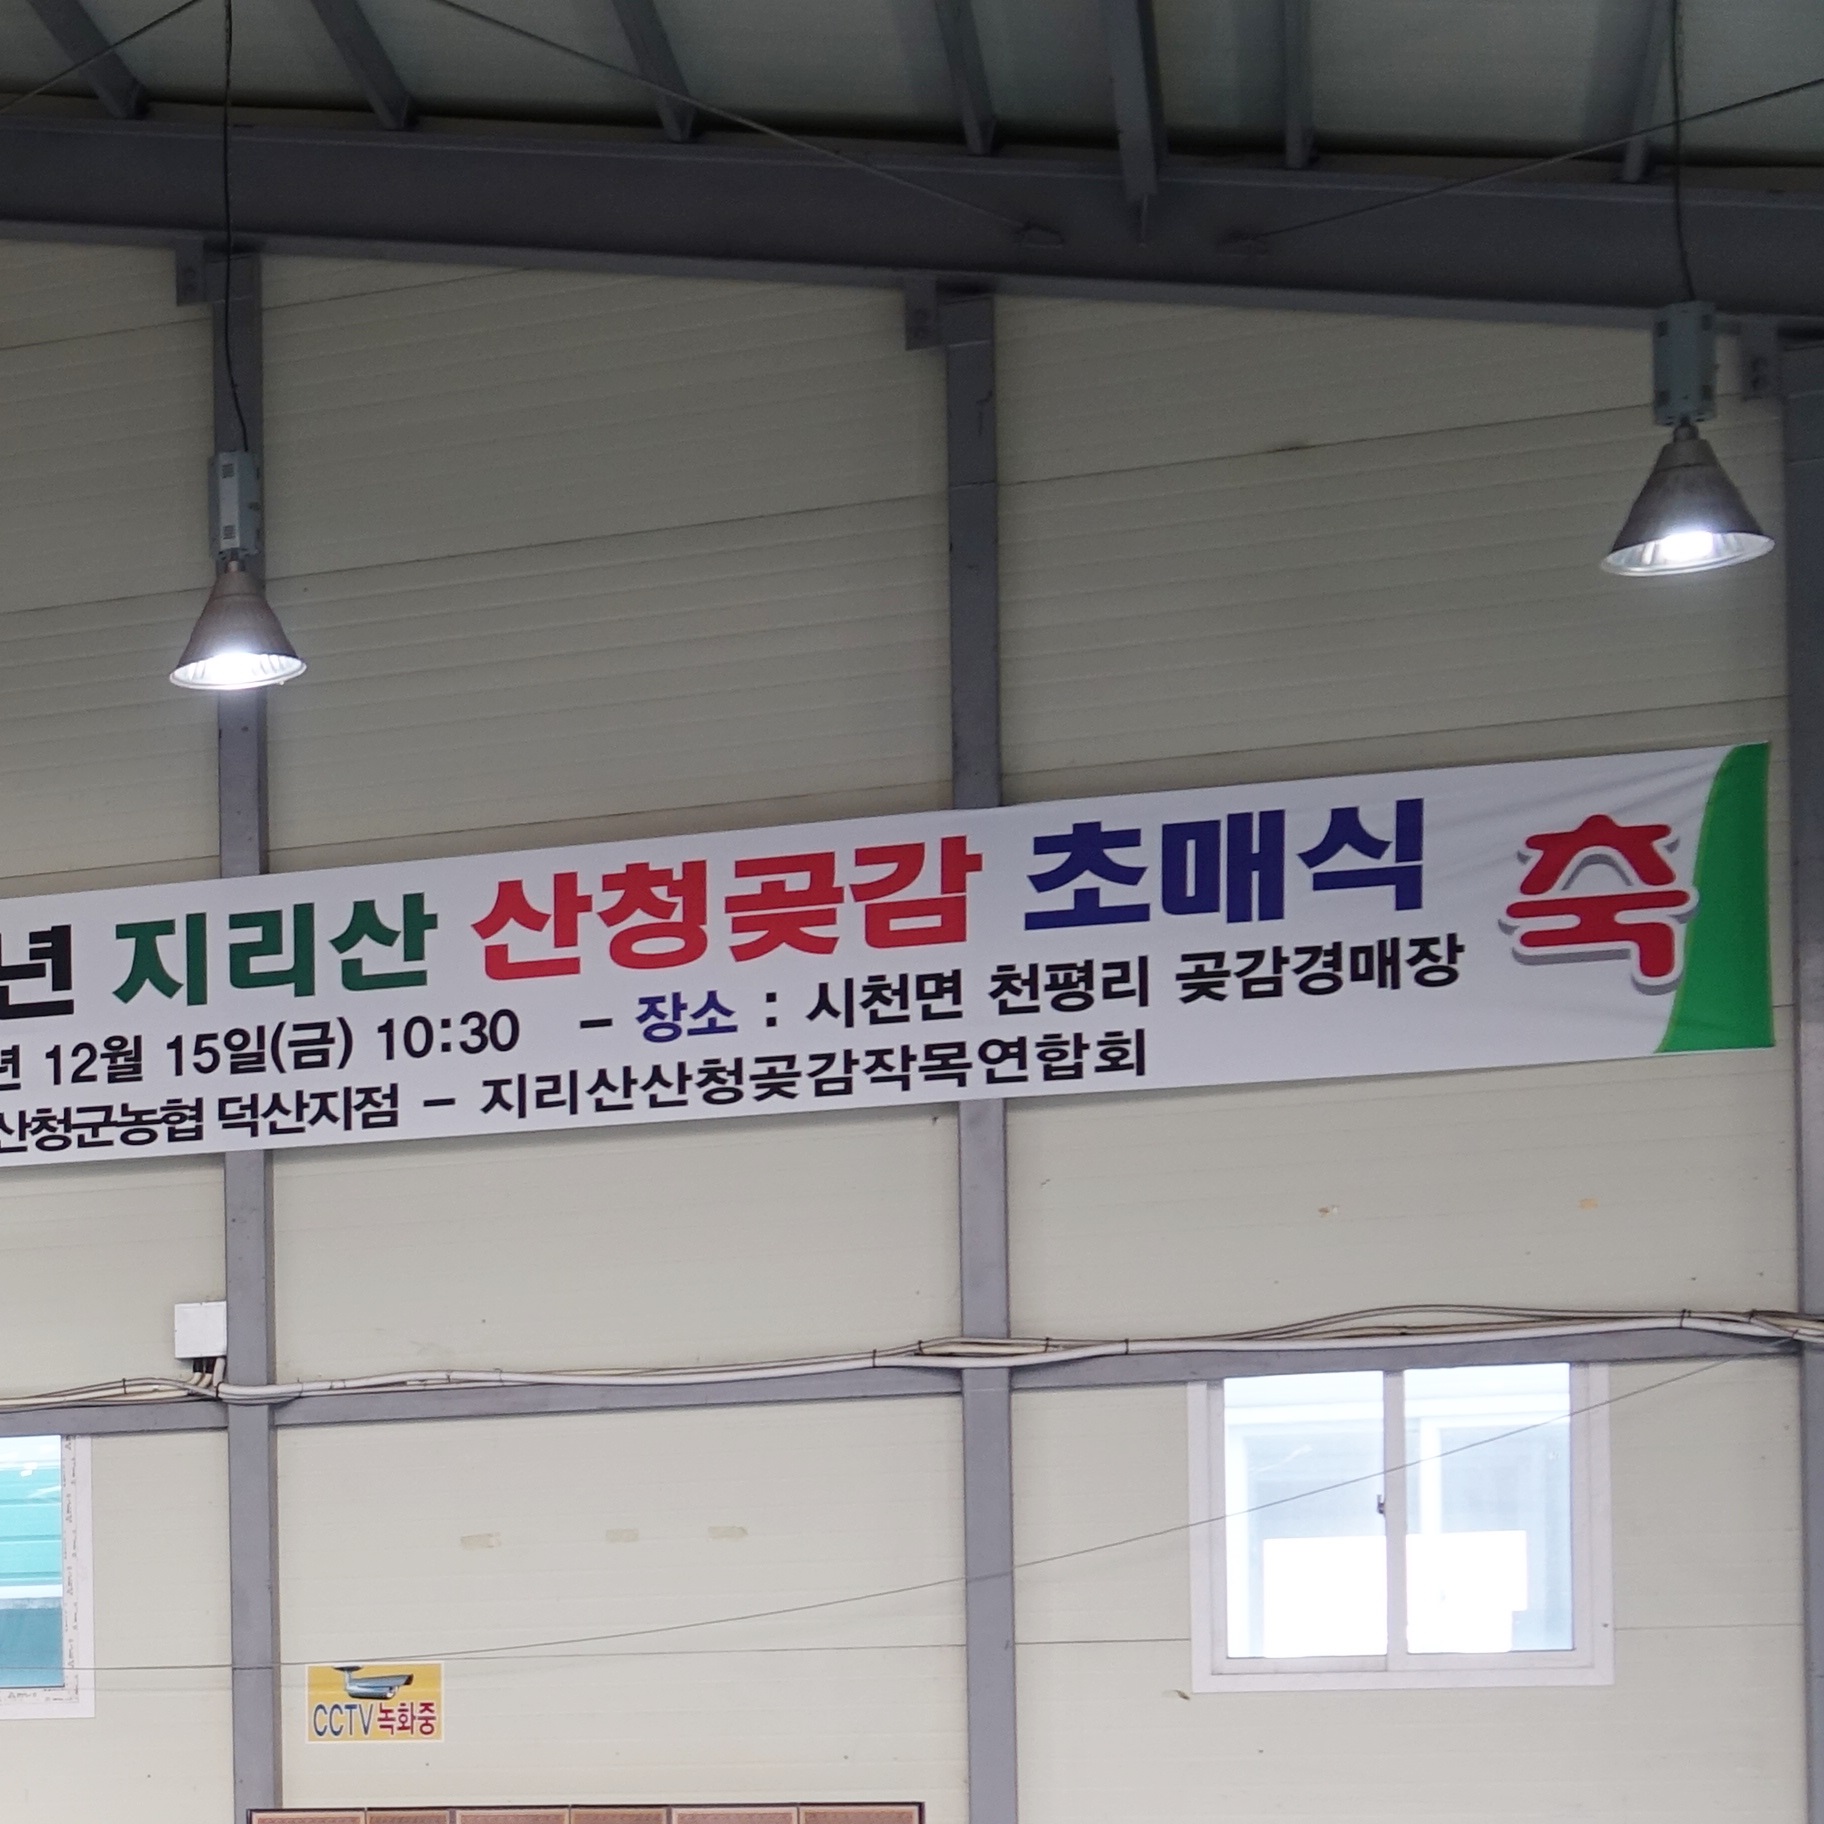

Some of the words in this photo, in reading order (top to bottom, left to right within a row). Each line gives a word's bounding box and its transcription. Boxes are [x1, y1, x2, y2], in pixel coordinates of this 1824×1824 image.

[111, 892, 439, 1007] 지리산
[472, 835, 983, 981] 산청곶감
[1024, 797, 1425, 932] 초매식
[1502, 812, 1696, 988] 축
[44, 1034, 144, 1087] 12월
[166, 1016, 355, 1078] 15일(금)
[377, 1008, 521, 1061] 10:30
[635, 989, 739, 1044] 장소
[805, 967, 964, 1029] 시천면
[988, 955, 1152, 1018] 천평리
[1174, 932, 1466, 1005] 곶감경매장
[217, 1083, 402, 1139] 덕산지점
[480, 1027, 1149, 1119] 지리산산청곶감작목연합회
